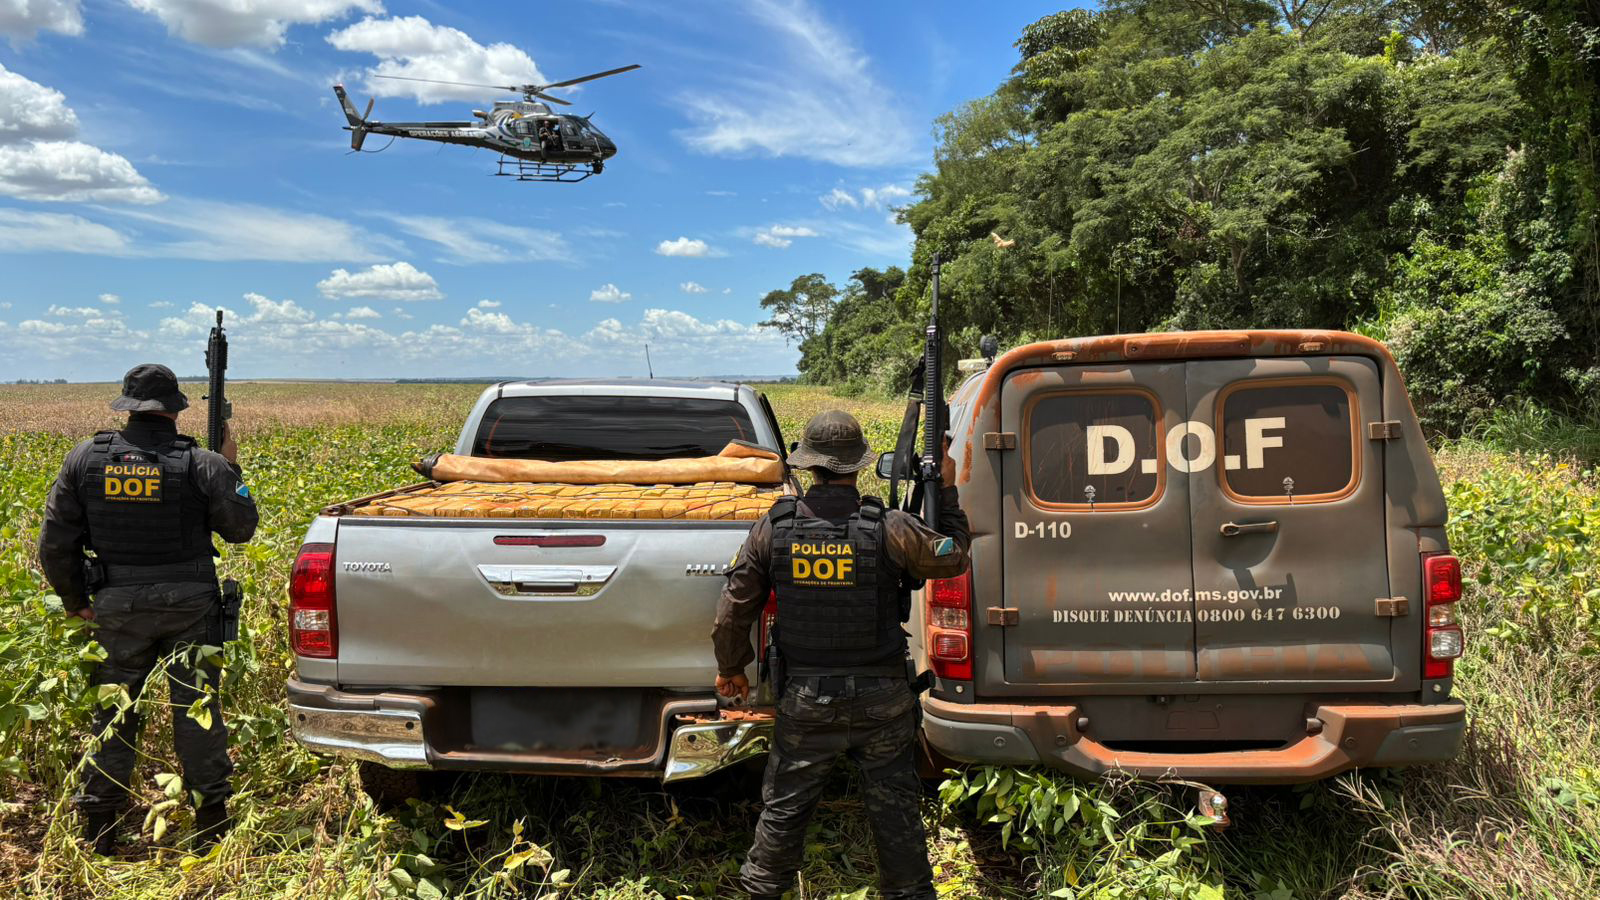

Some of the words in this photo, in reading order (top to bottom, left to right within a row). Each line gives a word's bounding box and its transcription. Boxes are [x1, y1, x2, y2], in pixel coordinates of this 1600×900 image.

[408, 129, 449, 138] OPERAÇÕES
[1086, 416, 1287, 475] D.O.F
[105, 464, 161, 476] POLÍCIA
[105, 478, 161, 496] DOF
[1014, 521, 1072, 539] D-110
[791, 541, 853, 555] POLÍCIA
[342, 561, 393, 572] TOYOTA
[792, 558, 854, 579] DOF
[1108, 586, 1283, 603] www.dof.ms.gov.br
[1052, 609, 1110, 624] DISQUE
[1114, 606, 1193, 623] DENÚNCIA
[1198, 607, 1245, 623] 0800
[1251, 607, 1285, 621] 647
[1292, 606, 1341, 620] 6300
